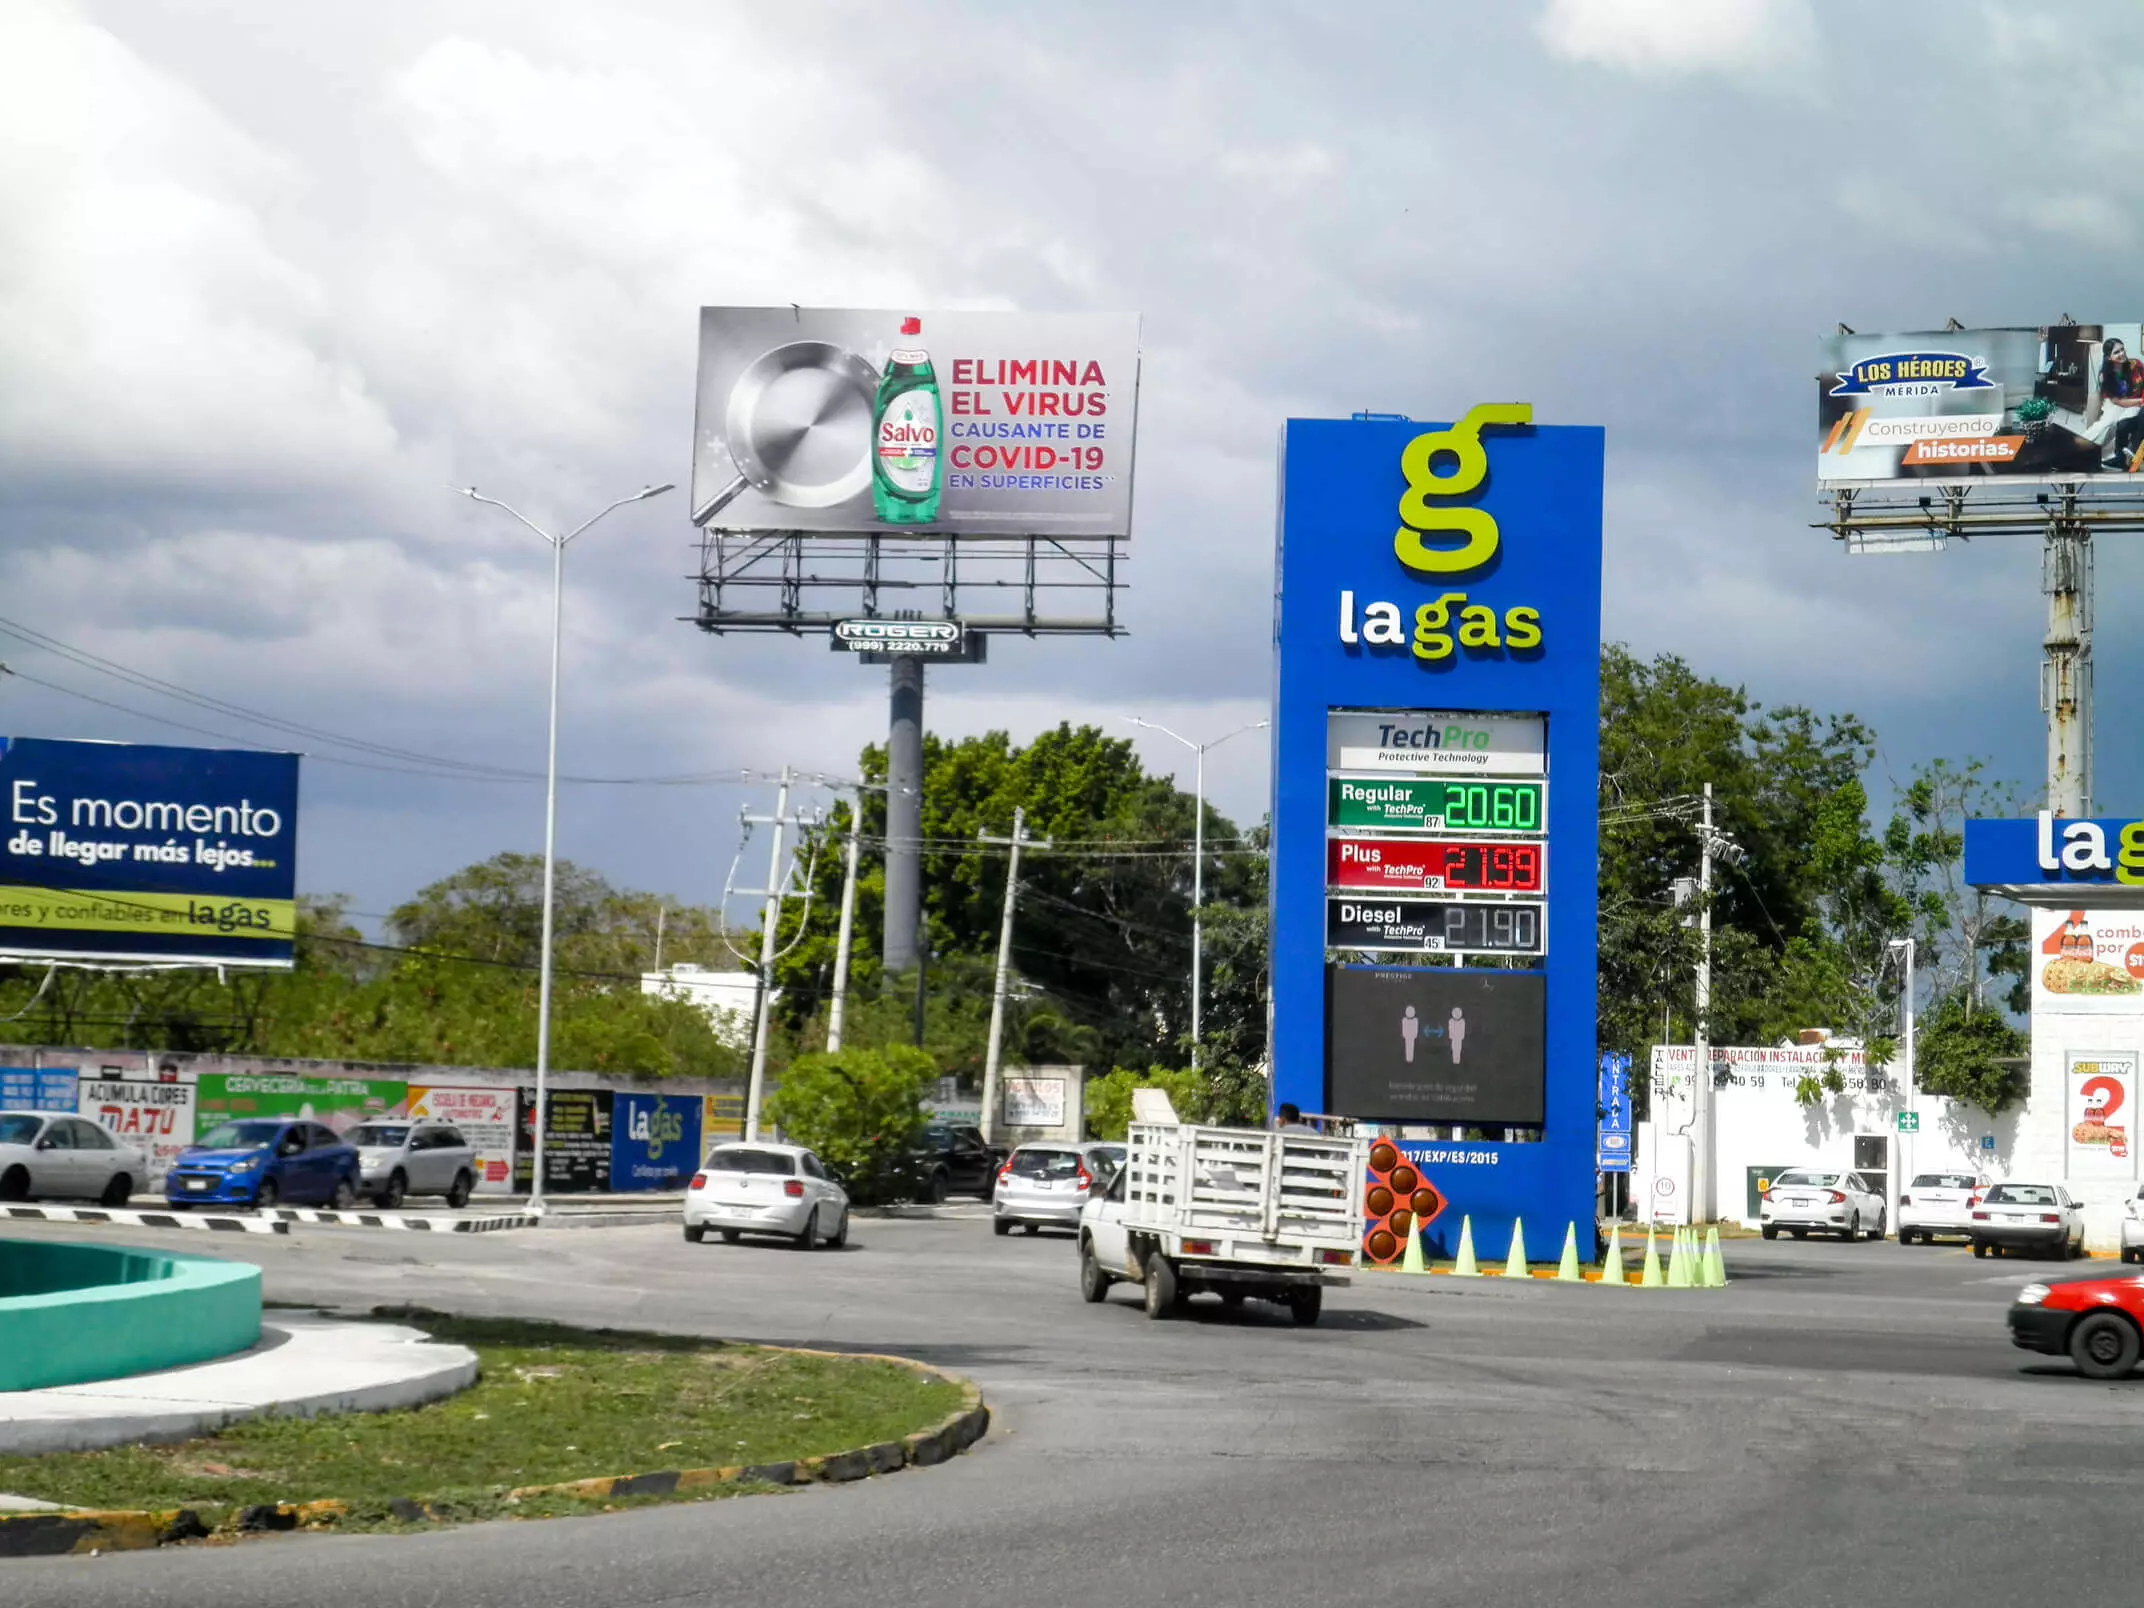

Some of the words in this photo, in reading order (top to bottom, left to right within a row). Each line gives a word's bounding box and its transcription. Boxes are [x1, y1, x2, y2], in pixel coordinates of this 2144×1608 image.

[952, 359, 1106, 386] ELIMINA
[1857, 363, 1891, 383] LOS
[1898, 356, 1967, 379] HÉROES
[951, 391, 991, 415] EL
[1002, 391, 1107, 416] VIRUS
[882, 422, 935, 443] Salvo
[951, 423, 1070, 438] CAUSANTE
[1077, 424, 1105, 439] DE
[1868, 418, 1994, 437] Construyendo
[950, 445, 1104, 471] COVID-19
[1918, 439, 2014, 459] historias.
[949, 475, 974, 488] EN
[981, 475, 1104, 489] SUPERFICIES
[843, 624, 952, 638] ROGER
[1339, 590, 1542, 660] lagas
[1379, 724, 1491, 749] TechPro
[1378, 751, 1430, 762] Protective
[1432, 752, 1489, 765] Technology
[11, 780, 58, 826] Es
[72, 798, 282, 838] momento
[1341, 784, 1413, 804] Regular
[1445, 787, 1535, 828] 20.60
[1384, 803, 1424, 815] TechPro
[1425, 816, 1439, 828] 87
[8, 829, 43, 855] de
[49, 830, 129, 866] llegar
[134, 838, 190, 863] más
[195, 837, 277, 873] lejos...
[1341, 845, 1381, 863] Plus
[1445, 847, 1535, 888] 21.99
[1366, 864, 1381, 872] with
[1384, 864, 1424, 875] TechPro
[1425, 877, 1439, 889] 92
[37, 906, 49, 922] y
[55, 901, 153, 923] confiables
[189, 900, 271, 932] lagas
[1341, 904, 1402, 923] Diesel
[1384, 925, 1424, 936] TechPro
[2096, 944, 2124, 957] por
[1668, 1049, 1696, 1061] VENT
[2072, 1061, 2132, 1074] SUBWAY
[2080, 1076, 2125, 1129] 2
